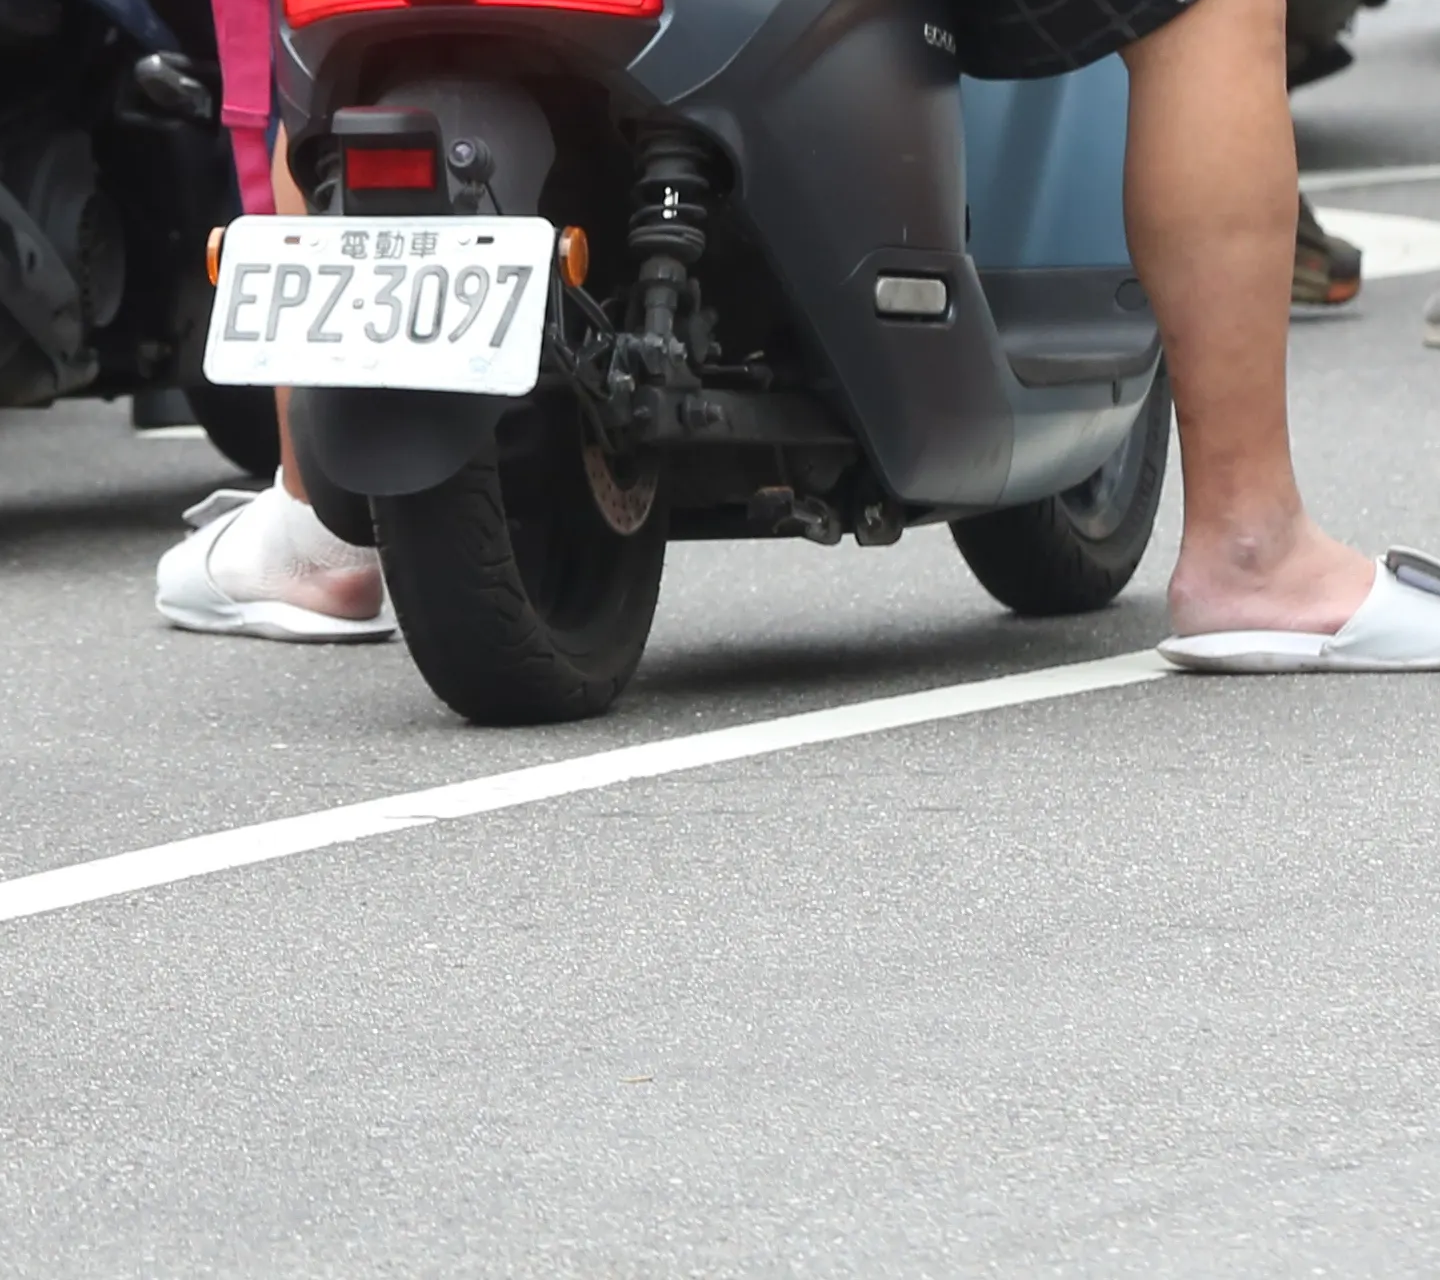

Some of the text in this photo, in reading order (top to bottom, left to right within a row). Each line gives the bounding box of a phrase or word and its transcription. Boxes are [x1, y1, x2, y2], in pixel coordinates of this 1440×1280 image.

[341, 230, 439, 259] 電動車
[223, 263, 534, 348] EPZ-3097
